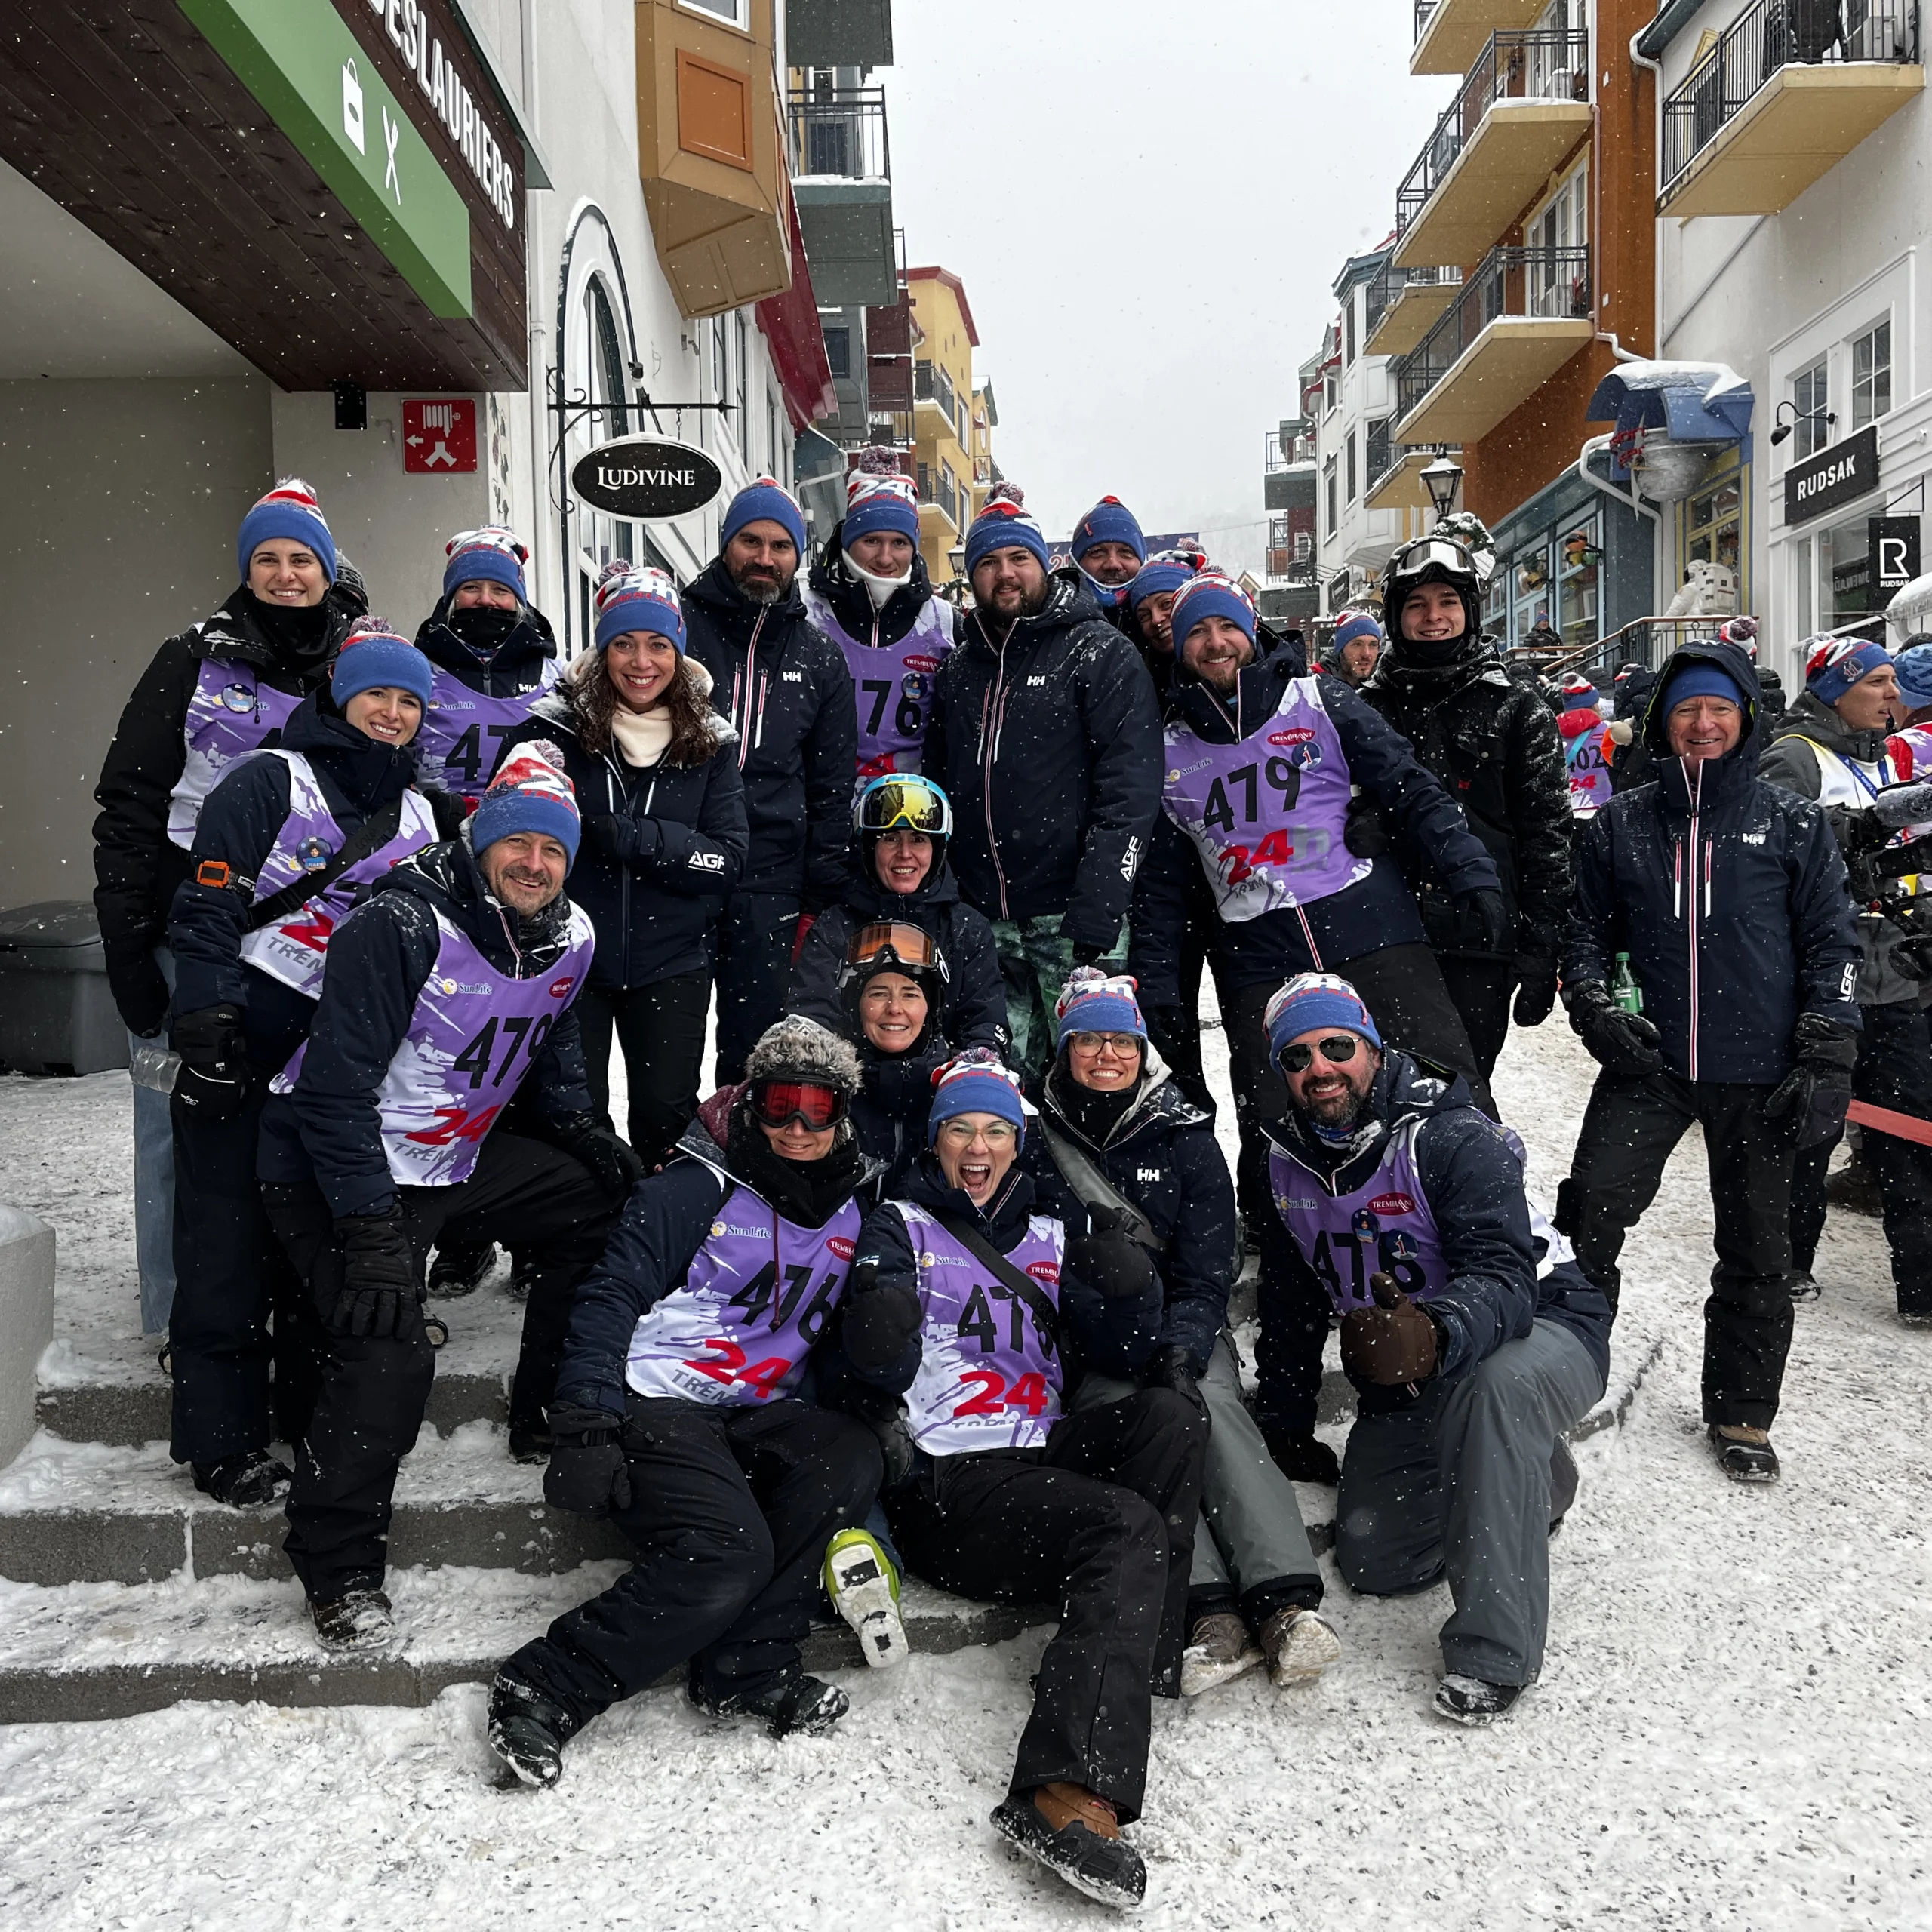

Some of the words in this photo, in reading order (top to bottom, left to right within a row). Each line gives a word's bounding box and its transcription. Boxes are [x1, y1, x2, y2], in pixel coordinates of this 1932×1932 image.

[370, 0, 514, 229] ESLAURIERS
[597, 466, 695, 491] LUDIVINE
[1798, 454, 1856, 501] RUDSAK
[1880, 580, 1910, 588] RUDSAK
[783, 671, 802, 682] HH
[1026, 675, 1046, 686] HH
[255, 701, 271, 711] ife
[861, 678, 921, 737] 76
[445, 723, 518, 792] 47
[1180, 764, 1196, 777] Sun
[1196, 757, 1214, 771] Life
[1203, 756, 1300, 833] 479
[1743, 832, 1766, 845] HH
[1120, 835, 1138, 882] AGF
[458, 982, 475, 994] Sun
[476, 983, 493, 995] Life
[452, 1012, 553, 1089] 479
[1137, 1168, 1160, 1182] HH
[727, 1225, 748, 1236] Sun
[749, 1226, 771, 1239] Life
[728, 1260, 840, 1345] 476
